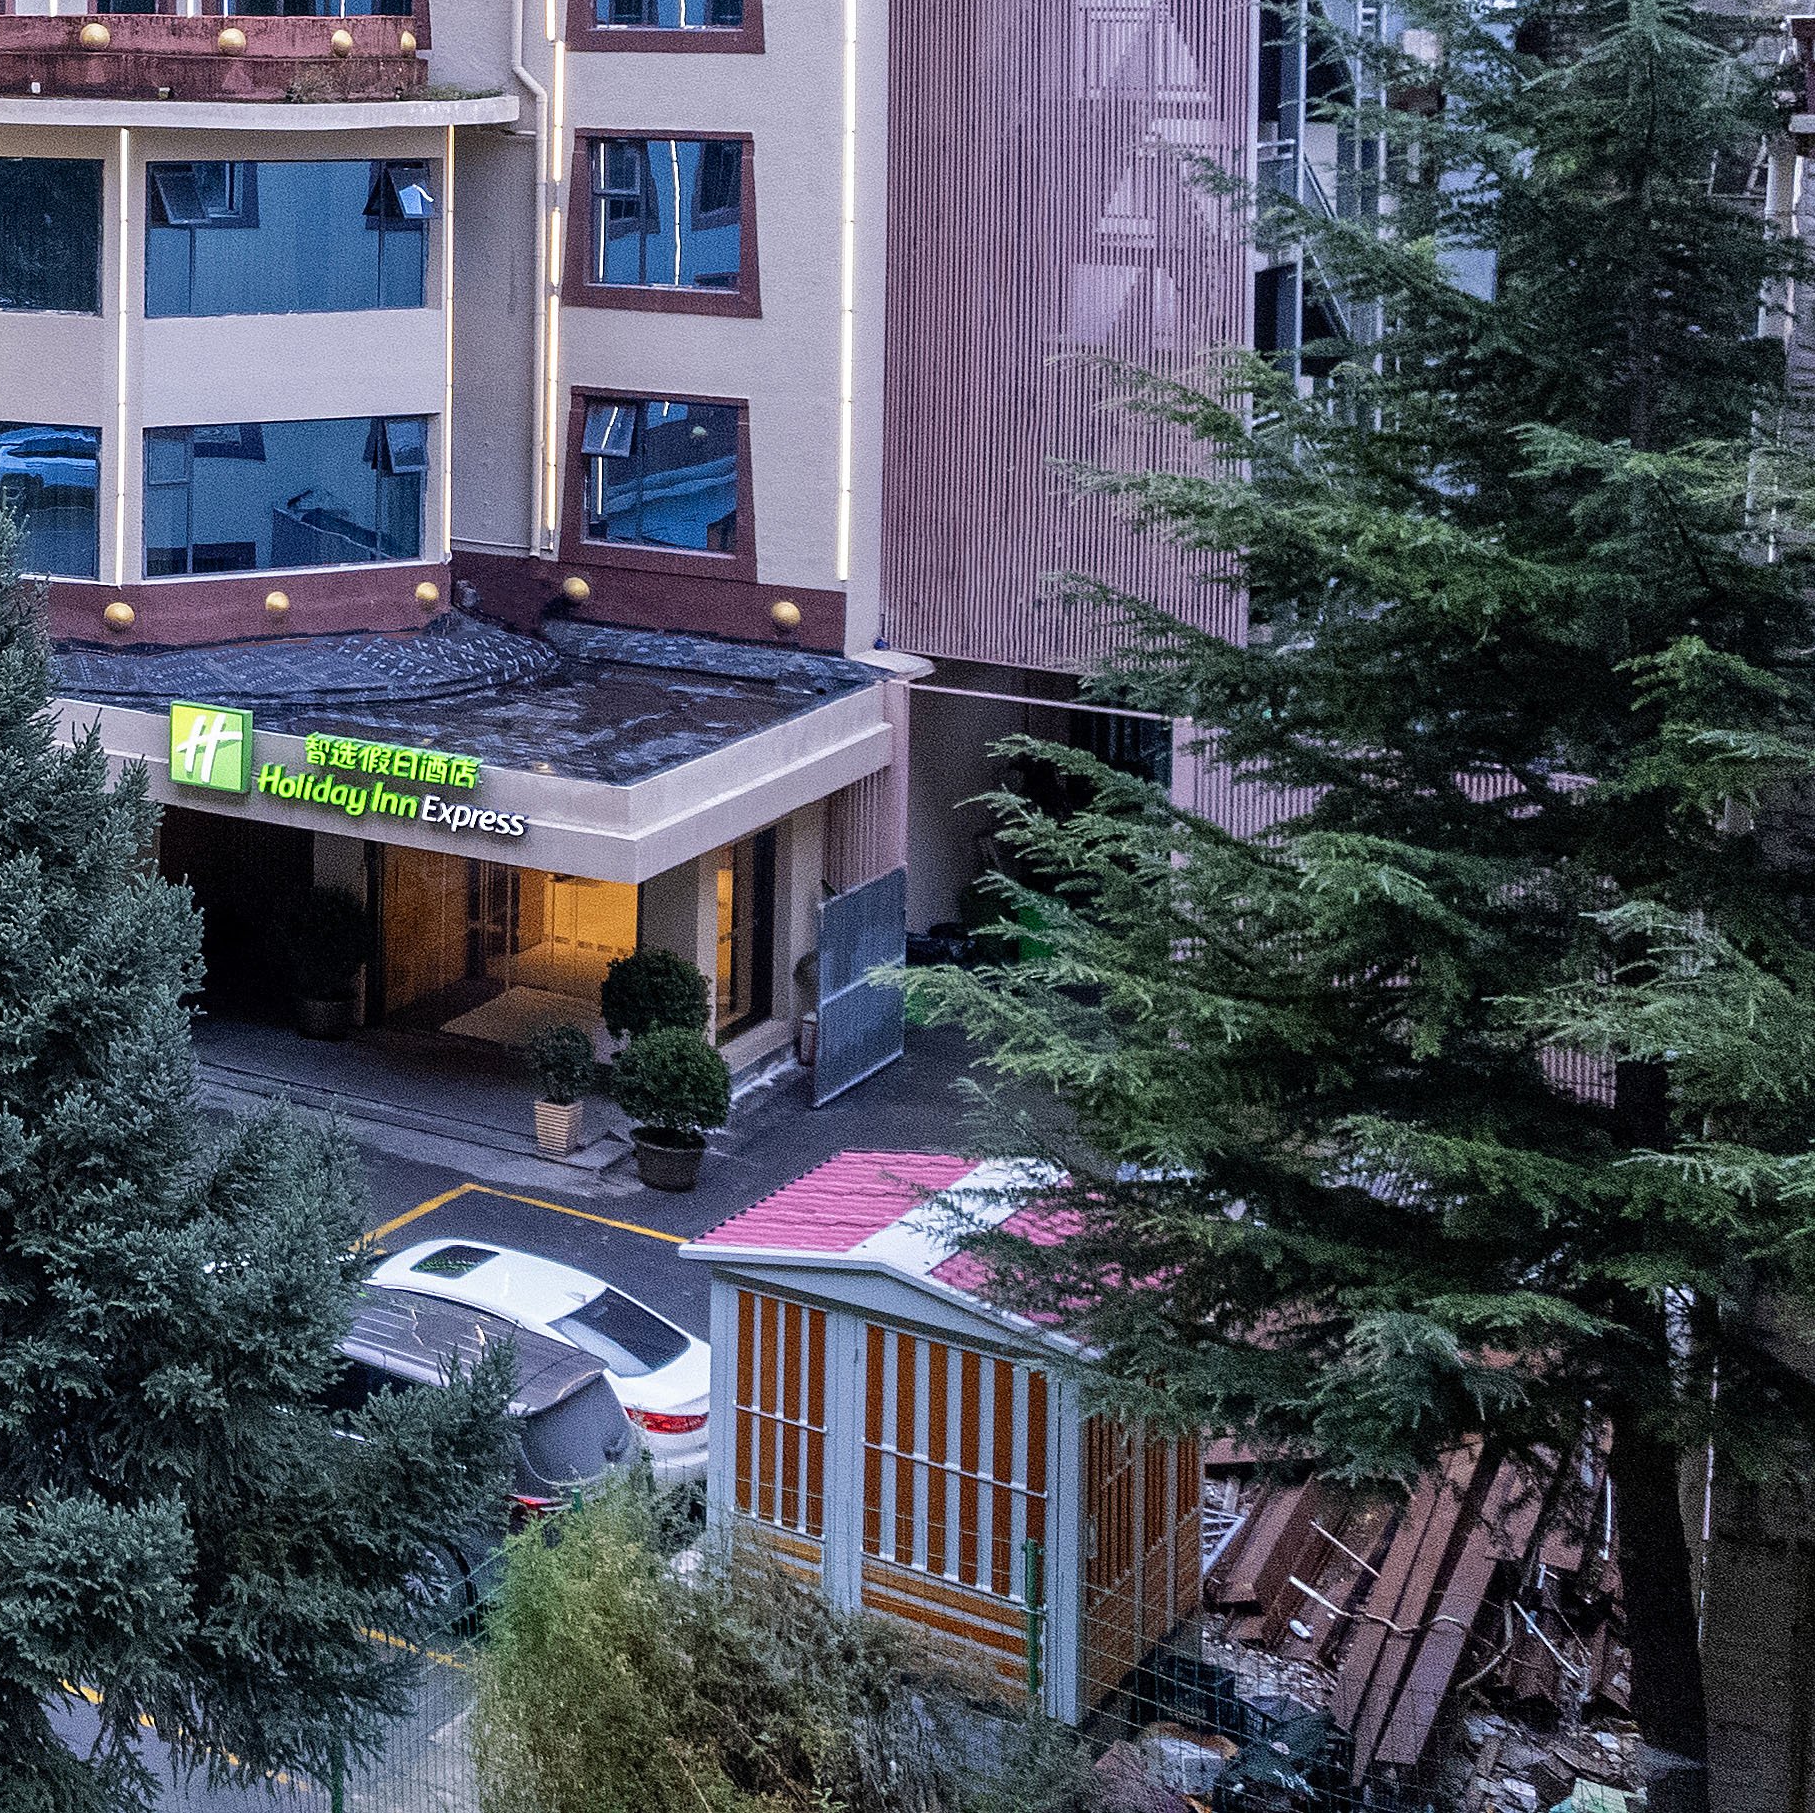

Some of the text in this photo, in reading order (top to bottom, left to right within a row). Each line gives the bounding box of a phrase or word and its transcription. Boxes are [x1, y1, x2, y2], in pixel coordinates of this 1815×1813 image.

[304, 733, 480, 789] 智选假日酒店
[257, 763, 527, 838] Holiday Inn Express
